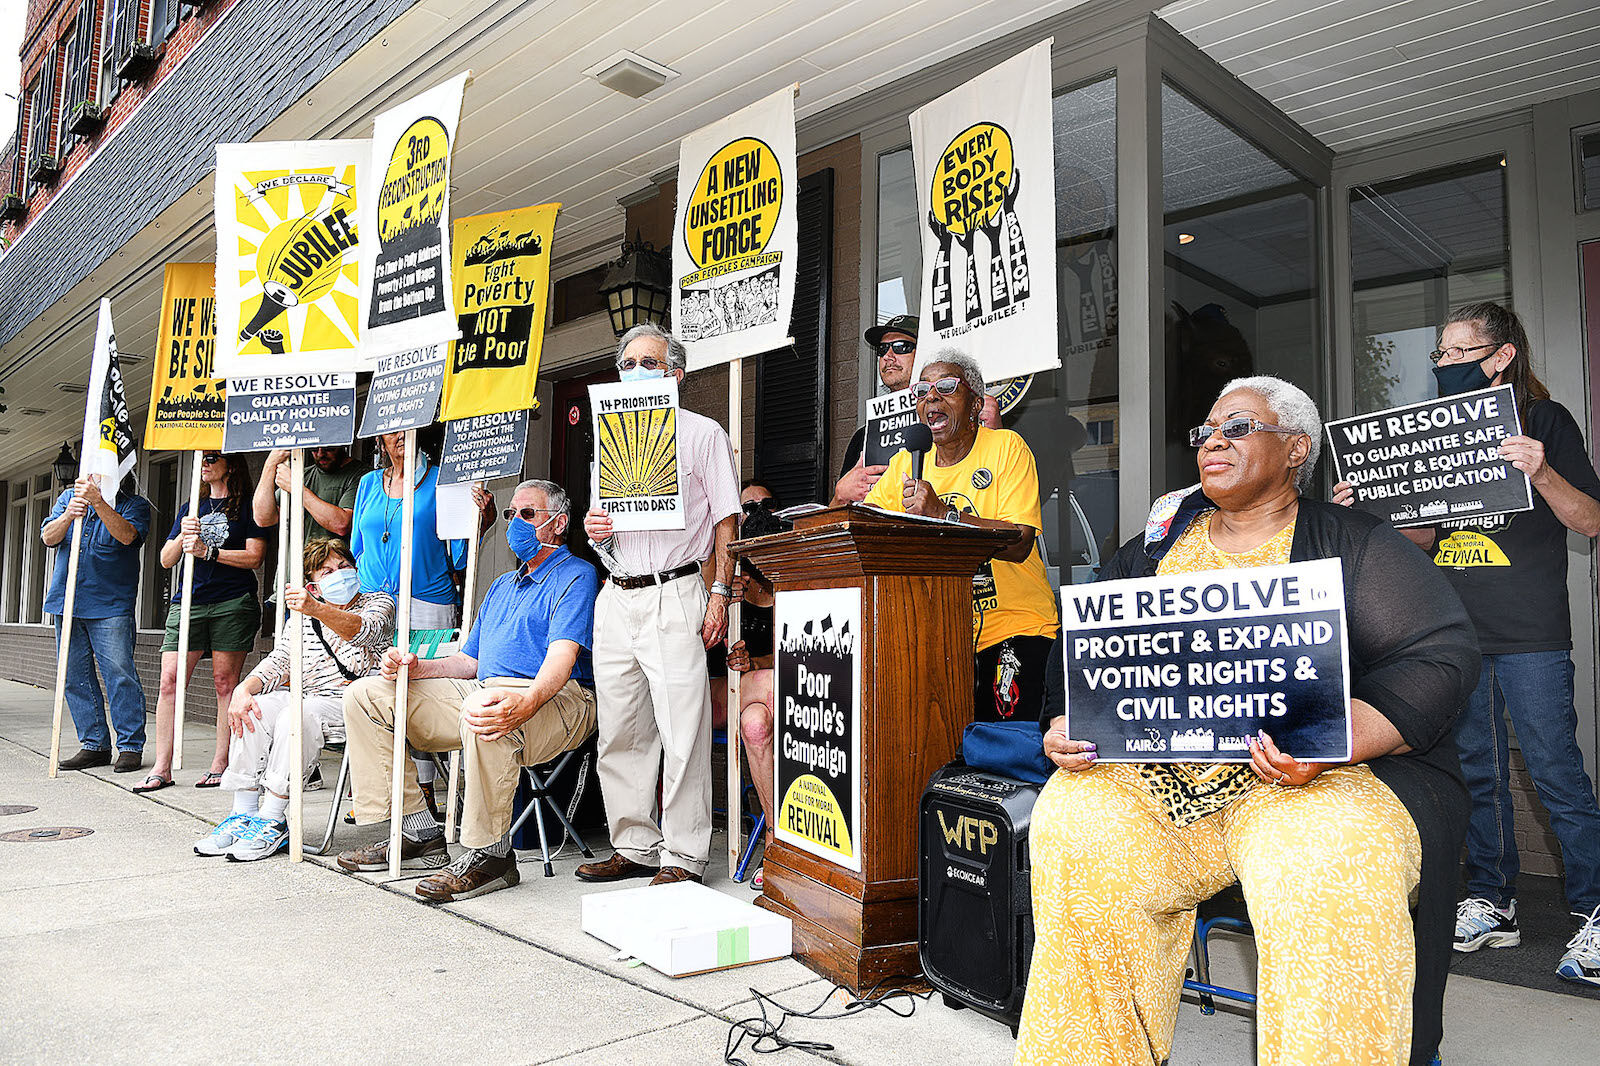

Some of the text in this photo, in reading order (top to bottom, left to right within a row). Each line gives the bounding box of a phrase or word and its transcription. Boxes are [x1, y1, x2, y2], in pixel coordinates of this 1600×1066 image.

[407, 135, 430, 170] 3RD
[943, 127, 995, 175] EVERY
[260, 174, 330, 190] WE DECLARE
[381, 156, 446, 209] RECONSTRUCTION
[706, 148, 761, 196] A NEW
[942, 149, 998, 199] BODY
[690, 177, 778, 230] UNSETTLING
[944, 170, 1006, 226] RISES
[278, 208, 359, 289] JUBILEE
[701, 213, 762, 265] FORCE
[1005, 212, 1029, 296] BOTTOM
[485, 260, 515, 282] Fight
[681, 274, 699, 286] POOR
[740, 253, 779, 268] CAMPAIGN
[991, 255, 1006, 301] THE
[465, 277, 535, 307] Poverty
[932, 250, 951, 322] LIFT
[966, 255, 979, 314] FROM
[172, 298, 196, 337] WE
[474, 308, 512, 335] NOT
[484, 336, 526, 360] Poor
[940, 329, 950, 339] WE
[169, 339, 215, 379] BE SIL
[378, 345, 438, 373] WE RESOLVE
[232, 378, 258, 392] WE
[264, 374, 339, 390] RESOLVE
[373, 374, 404, 391] PROTECT
[412, 365, 444, 382] EXPAND
[252, 393, 330, 408] GUARANTEE
[373, 388, 401, 404] VOTING
[400, 383, 429, 398] RIGHTS
[378, 398, 424, 417] CIVIL RIGHTS
[600, 395, 670, 411] 14 PRIORITIES
[873, 393, 916, 416] WE RE
[158, 410, 176, 419] Poor
[177, 410, 210, 420] People's
[230, 405, 351, 425] QUALITY HOUSING
[263, 422, 316, 435] FOR ALL
[452, 410, 522, 434] WE RESOLVE
[1342, 396, 1500, 445] WE RESOLVE
[452, 434, 515, 453] CONSTITUTIONAL
[457, 425, 515, 442] TO PROTECT THE
[880, 432, 906, 448] U.S.
[444, 443, 521, 464] RIGHTS OF ASSEMBLY
[462, 460, 480, 471] FREE
[479, 455, 508, 468] SPEECH
[1342, 452, 1365, 468] TO
[1367, 433, 1461, 463] GUARANTEE
[1345, 461, 1410, 487] QUALITY
[1413, 458, 1427, 474] &
[1357, 465, 1507, 502] PUBLIC EDUCATION
[601, 499, 676, 513] FIRST 100 DAYS
[1073, 577, 1327, 623] WE RESOLVE to
[1075, 620, 1333, 660] PROTECT & EXPAND
[797, 664, 831, 699] Poor
[1082, 655, 1319, 690] VOTING RIGHTS &
[785, 696, 845, 737] People's
[1116, 692, 1287, 721] CIVIL RIGHTS
[784, 732, 847, 778] Campaign
[1125, 738, 1168, 752] KAIROS
[792, 791, 804, 803] CALL
[798, 779, 827, 797] A NATIONAL
[788, 803, 840, 849] REVIVAL
[937, 810, 998, 855] WFP
